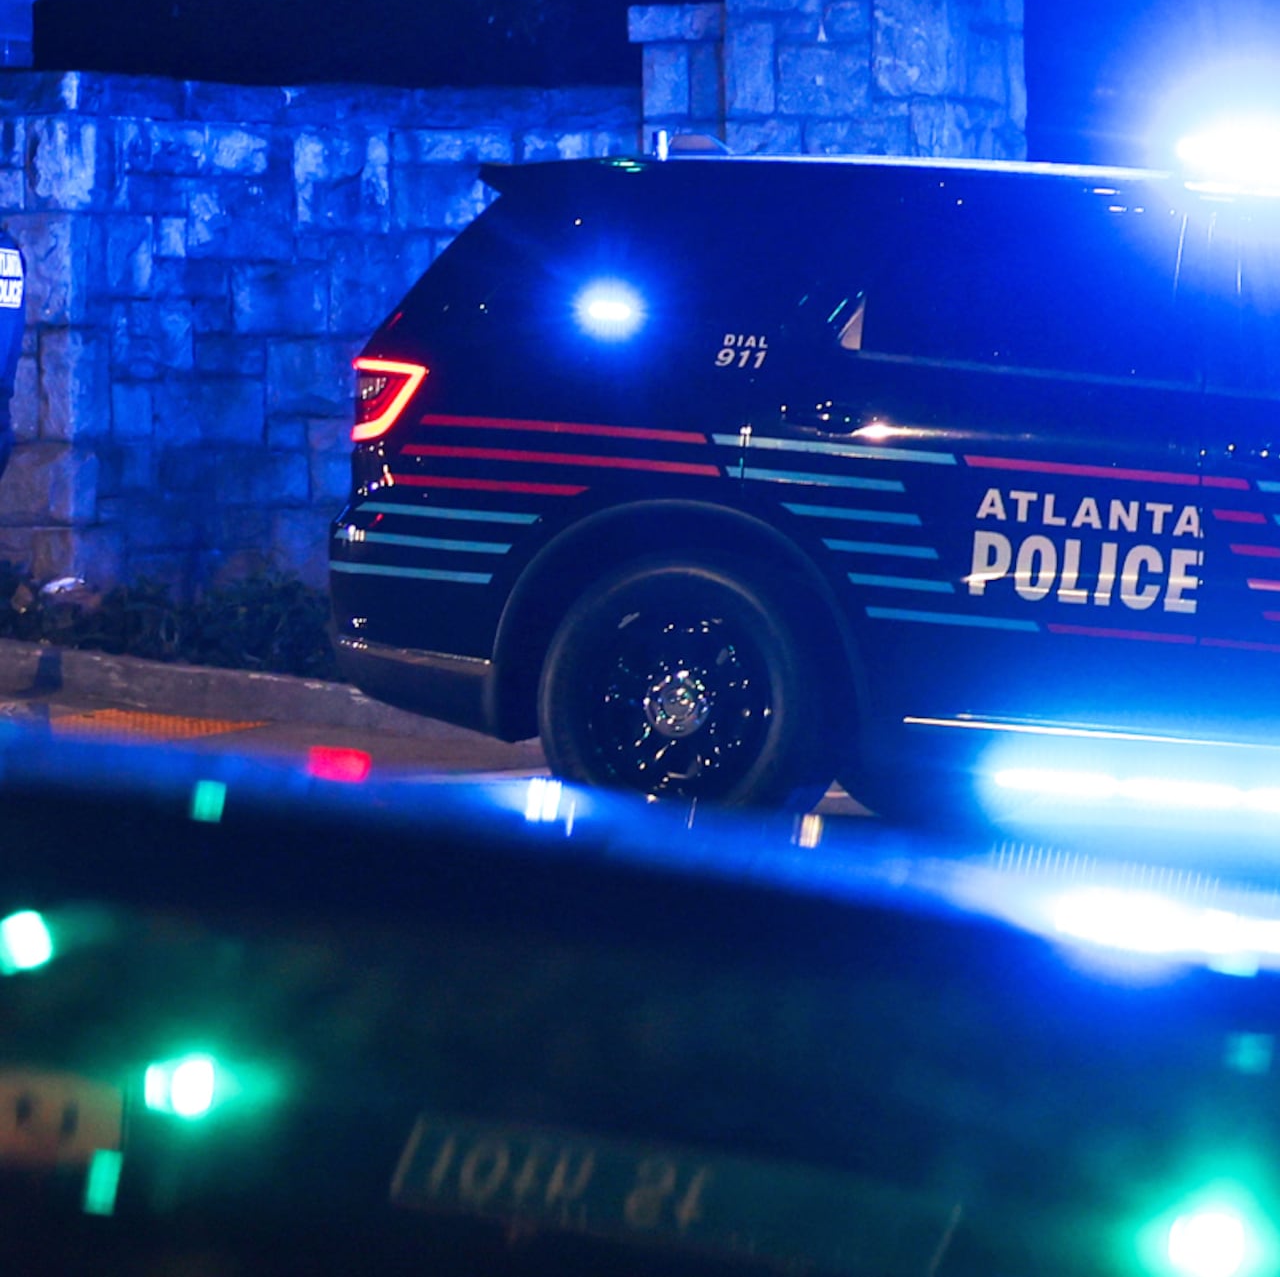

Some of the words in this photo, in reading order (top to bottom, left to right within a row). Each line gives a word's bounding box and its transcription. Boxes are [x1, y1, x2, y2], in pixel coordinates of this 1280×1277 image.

[714, 347, 767, 369] 911
[723, 333, 769, 349] DIAL
[975, 487, 1204, 539] ATLANTA
[967, 529, 1204, 614] POLICE
